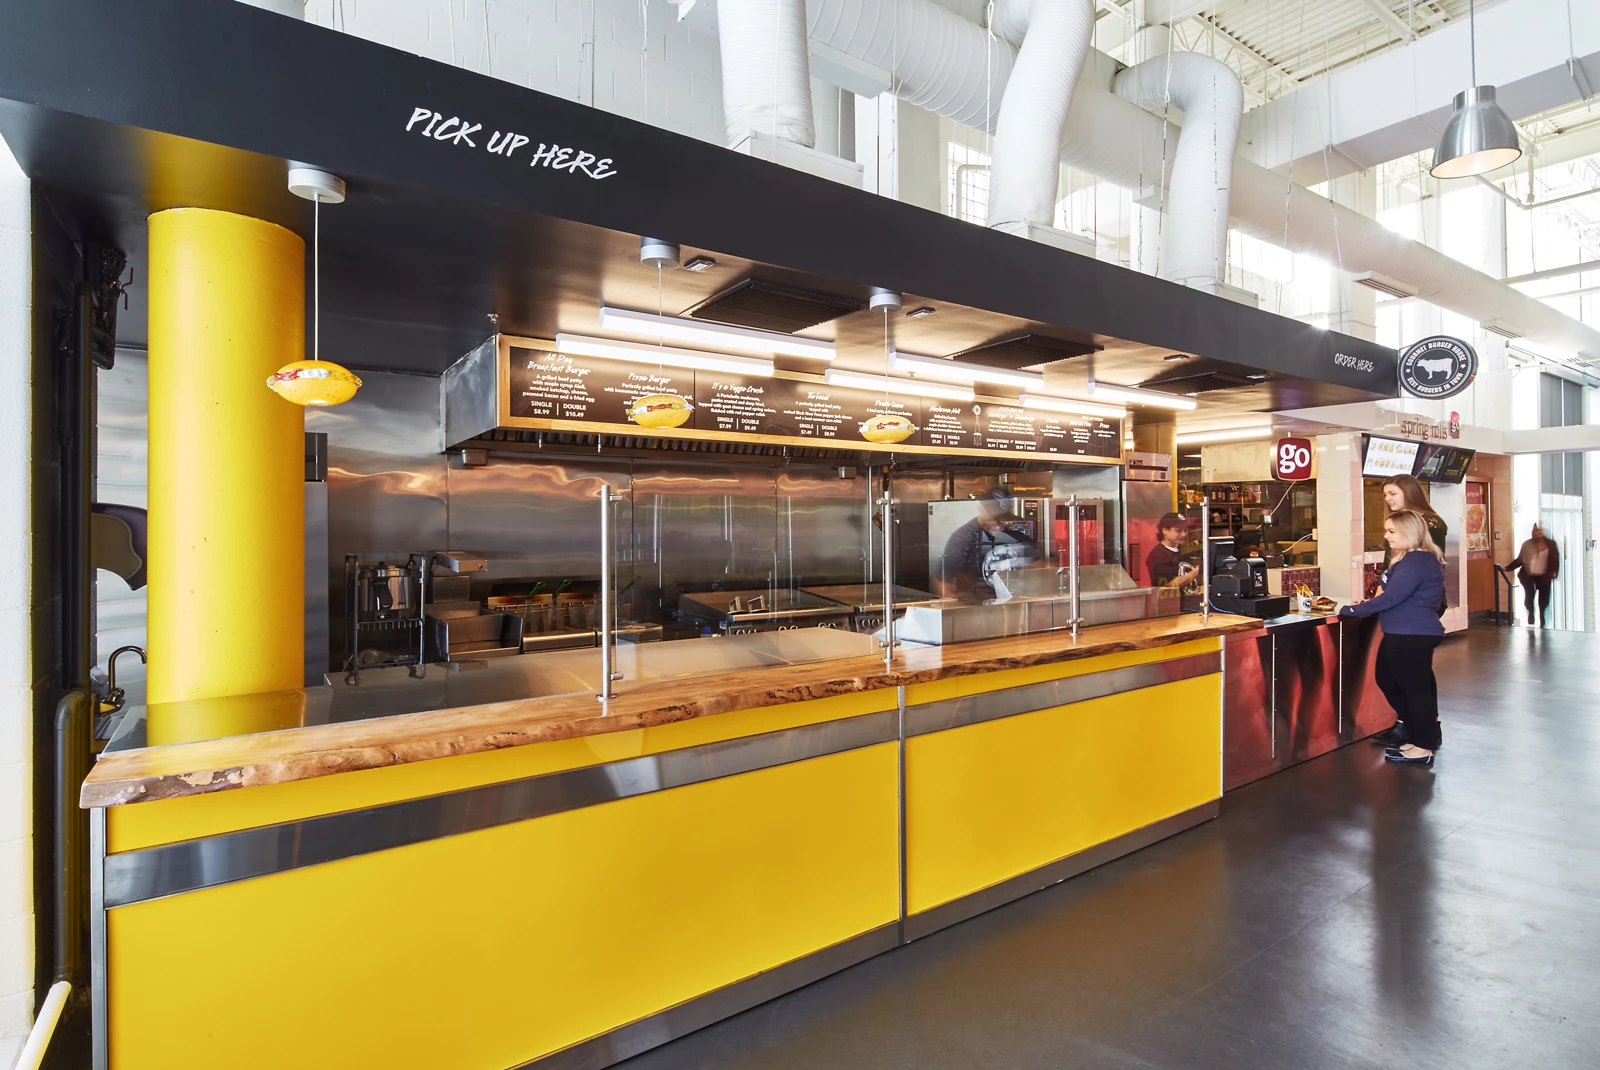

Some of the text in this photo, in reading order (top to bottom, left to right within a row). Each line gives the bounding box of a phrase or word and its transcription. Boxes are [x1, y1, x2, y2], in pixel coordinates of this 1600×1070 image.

[406, 107, 618, 180] PICK UP HERE
[544, 353, 574, 365] All Day
[1334, 353, 1374, 372] ORDER HERE
[1406, 342, 1466, 366] GOURMET BURGER HOUSE
[527, 361, 590, 376] Breakfast Burger
[648, 374, 672, 386] Burger
[1407, 376, 1418, 388] BEST
[1416, 384, 1442, 394] BURGERS
[1450, 372, 1464, 386] TOWN
[1400, 418, 1448, 440] spring rolls
[1280, 444, 1310, 474] go
